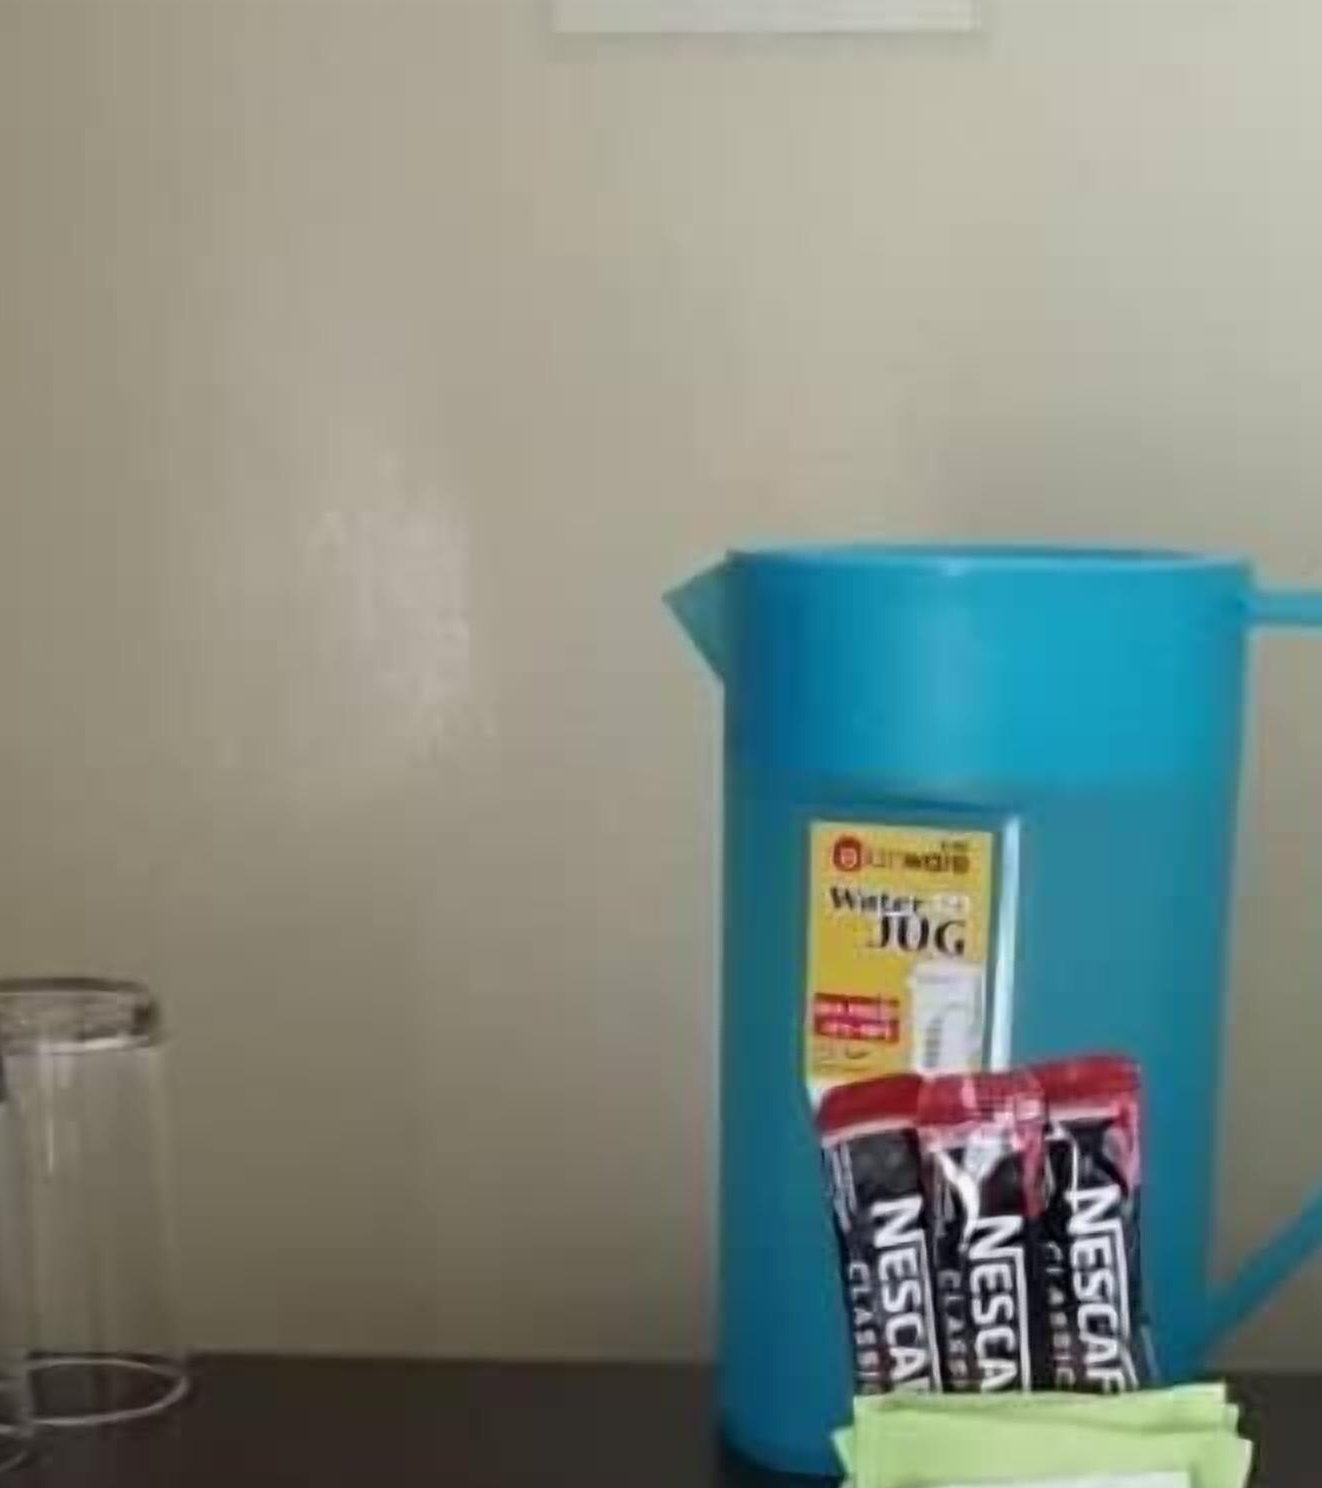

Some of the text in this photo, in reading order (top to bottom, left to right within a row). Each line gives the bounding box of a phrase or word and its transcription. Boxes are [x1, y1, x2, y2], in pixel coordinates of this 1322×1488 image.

[867, 914, 966, 956] JUG
[968, 1216, 1031, 1392] NESCA
[1065, 1184, 1135, 1394] NESCAF
